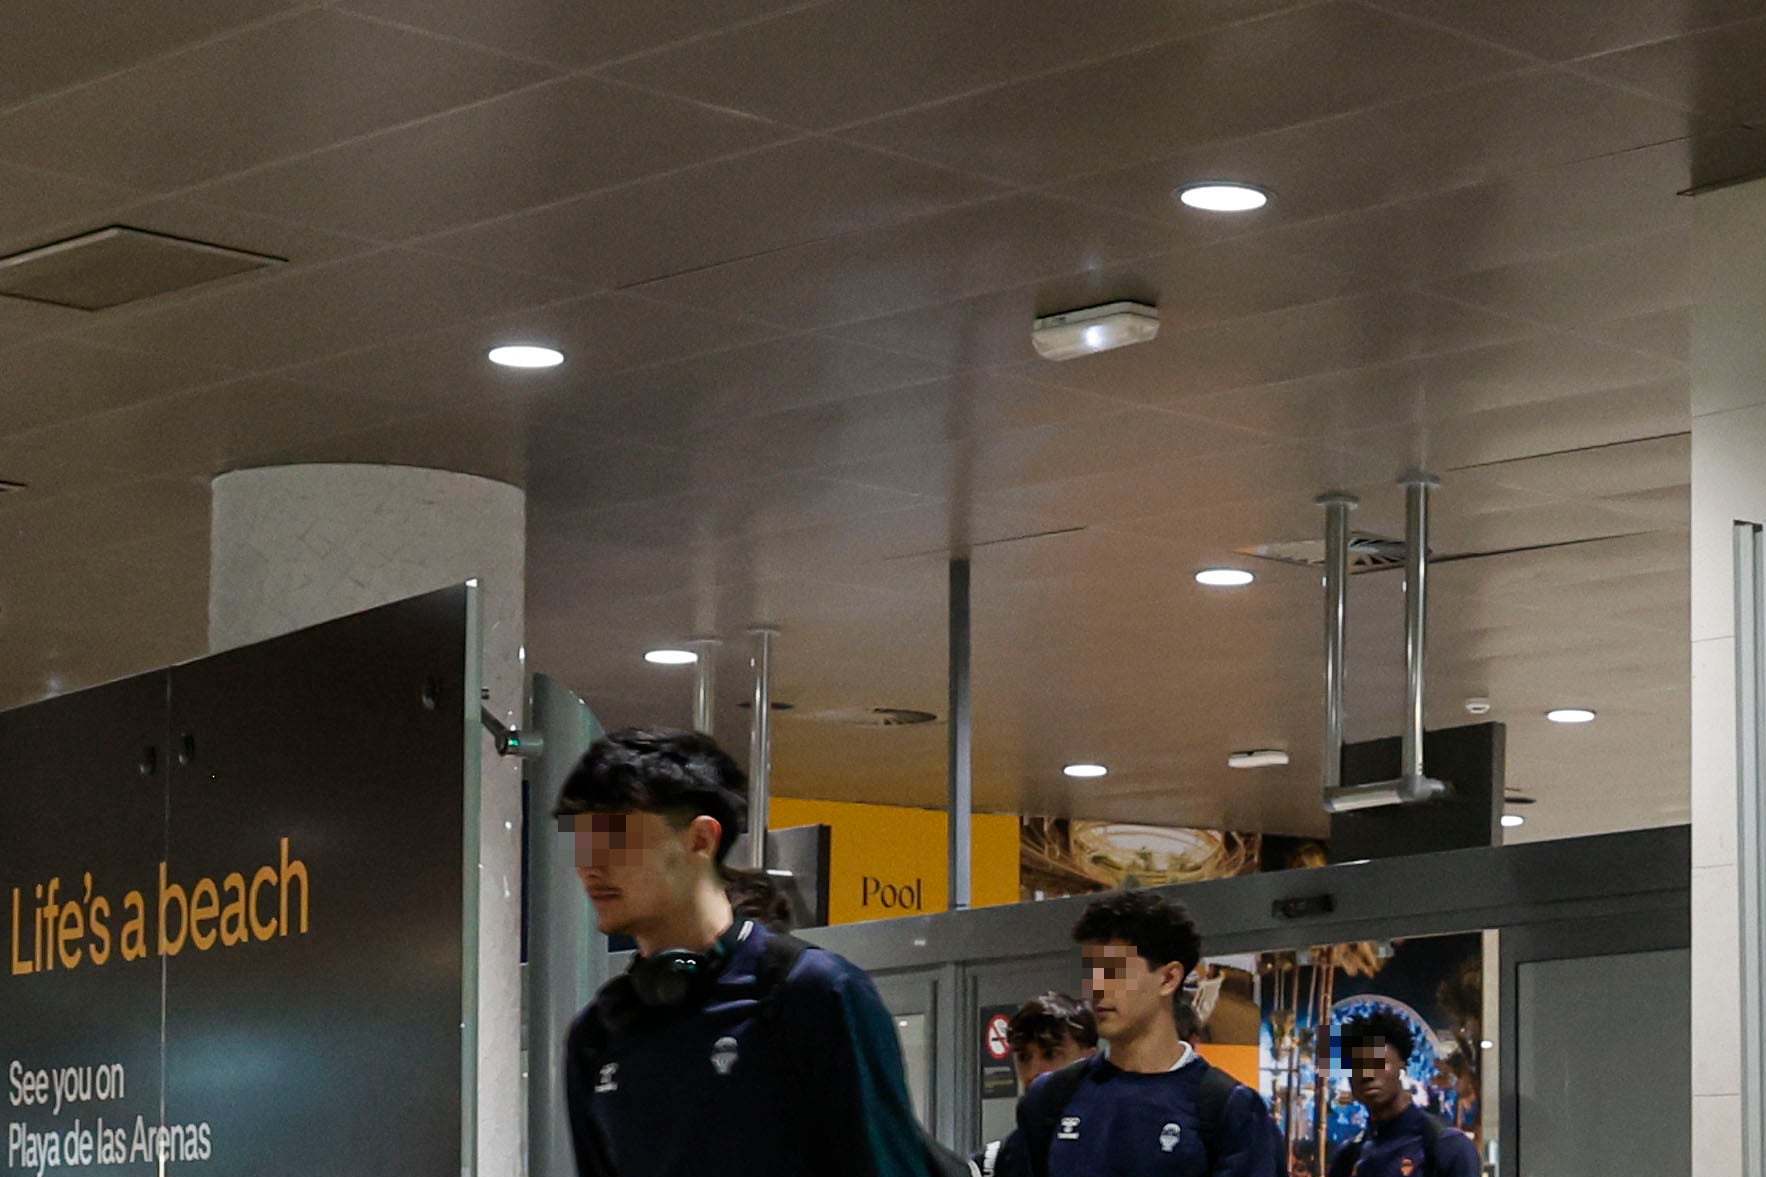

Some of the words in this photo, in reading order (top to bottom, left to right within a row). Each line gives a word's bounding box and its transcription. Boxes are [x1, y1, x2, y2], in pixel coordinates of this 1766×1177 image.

[12, 871, 110, 975] Life's
[120, 890, 147, 961] a
[158, 837, 308, 956] beach
[862, 876, 922, 911] Pool
[10, 1060, 49, 1106] See
[52, 1066, 92, 1116] you
[96, 1063, 124, 1100] on
[64, 1118, 93, 1166] de
[97, 1117, 127, 1165] las
[129, 1114, 212, 1163] Arenas
